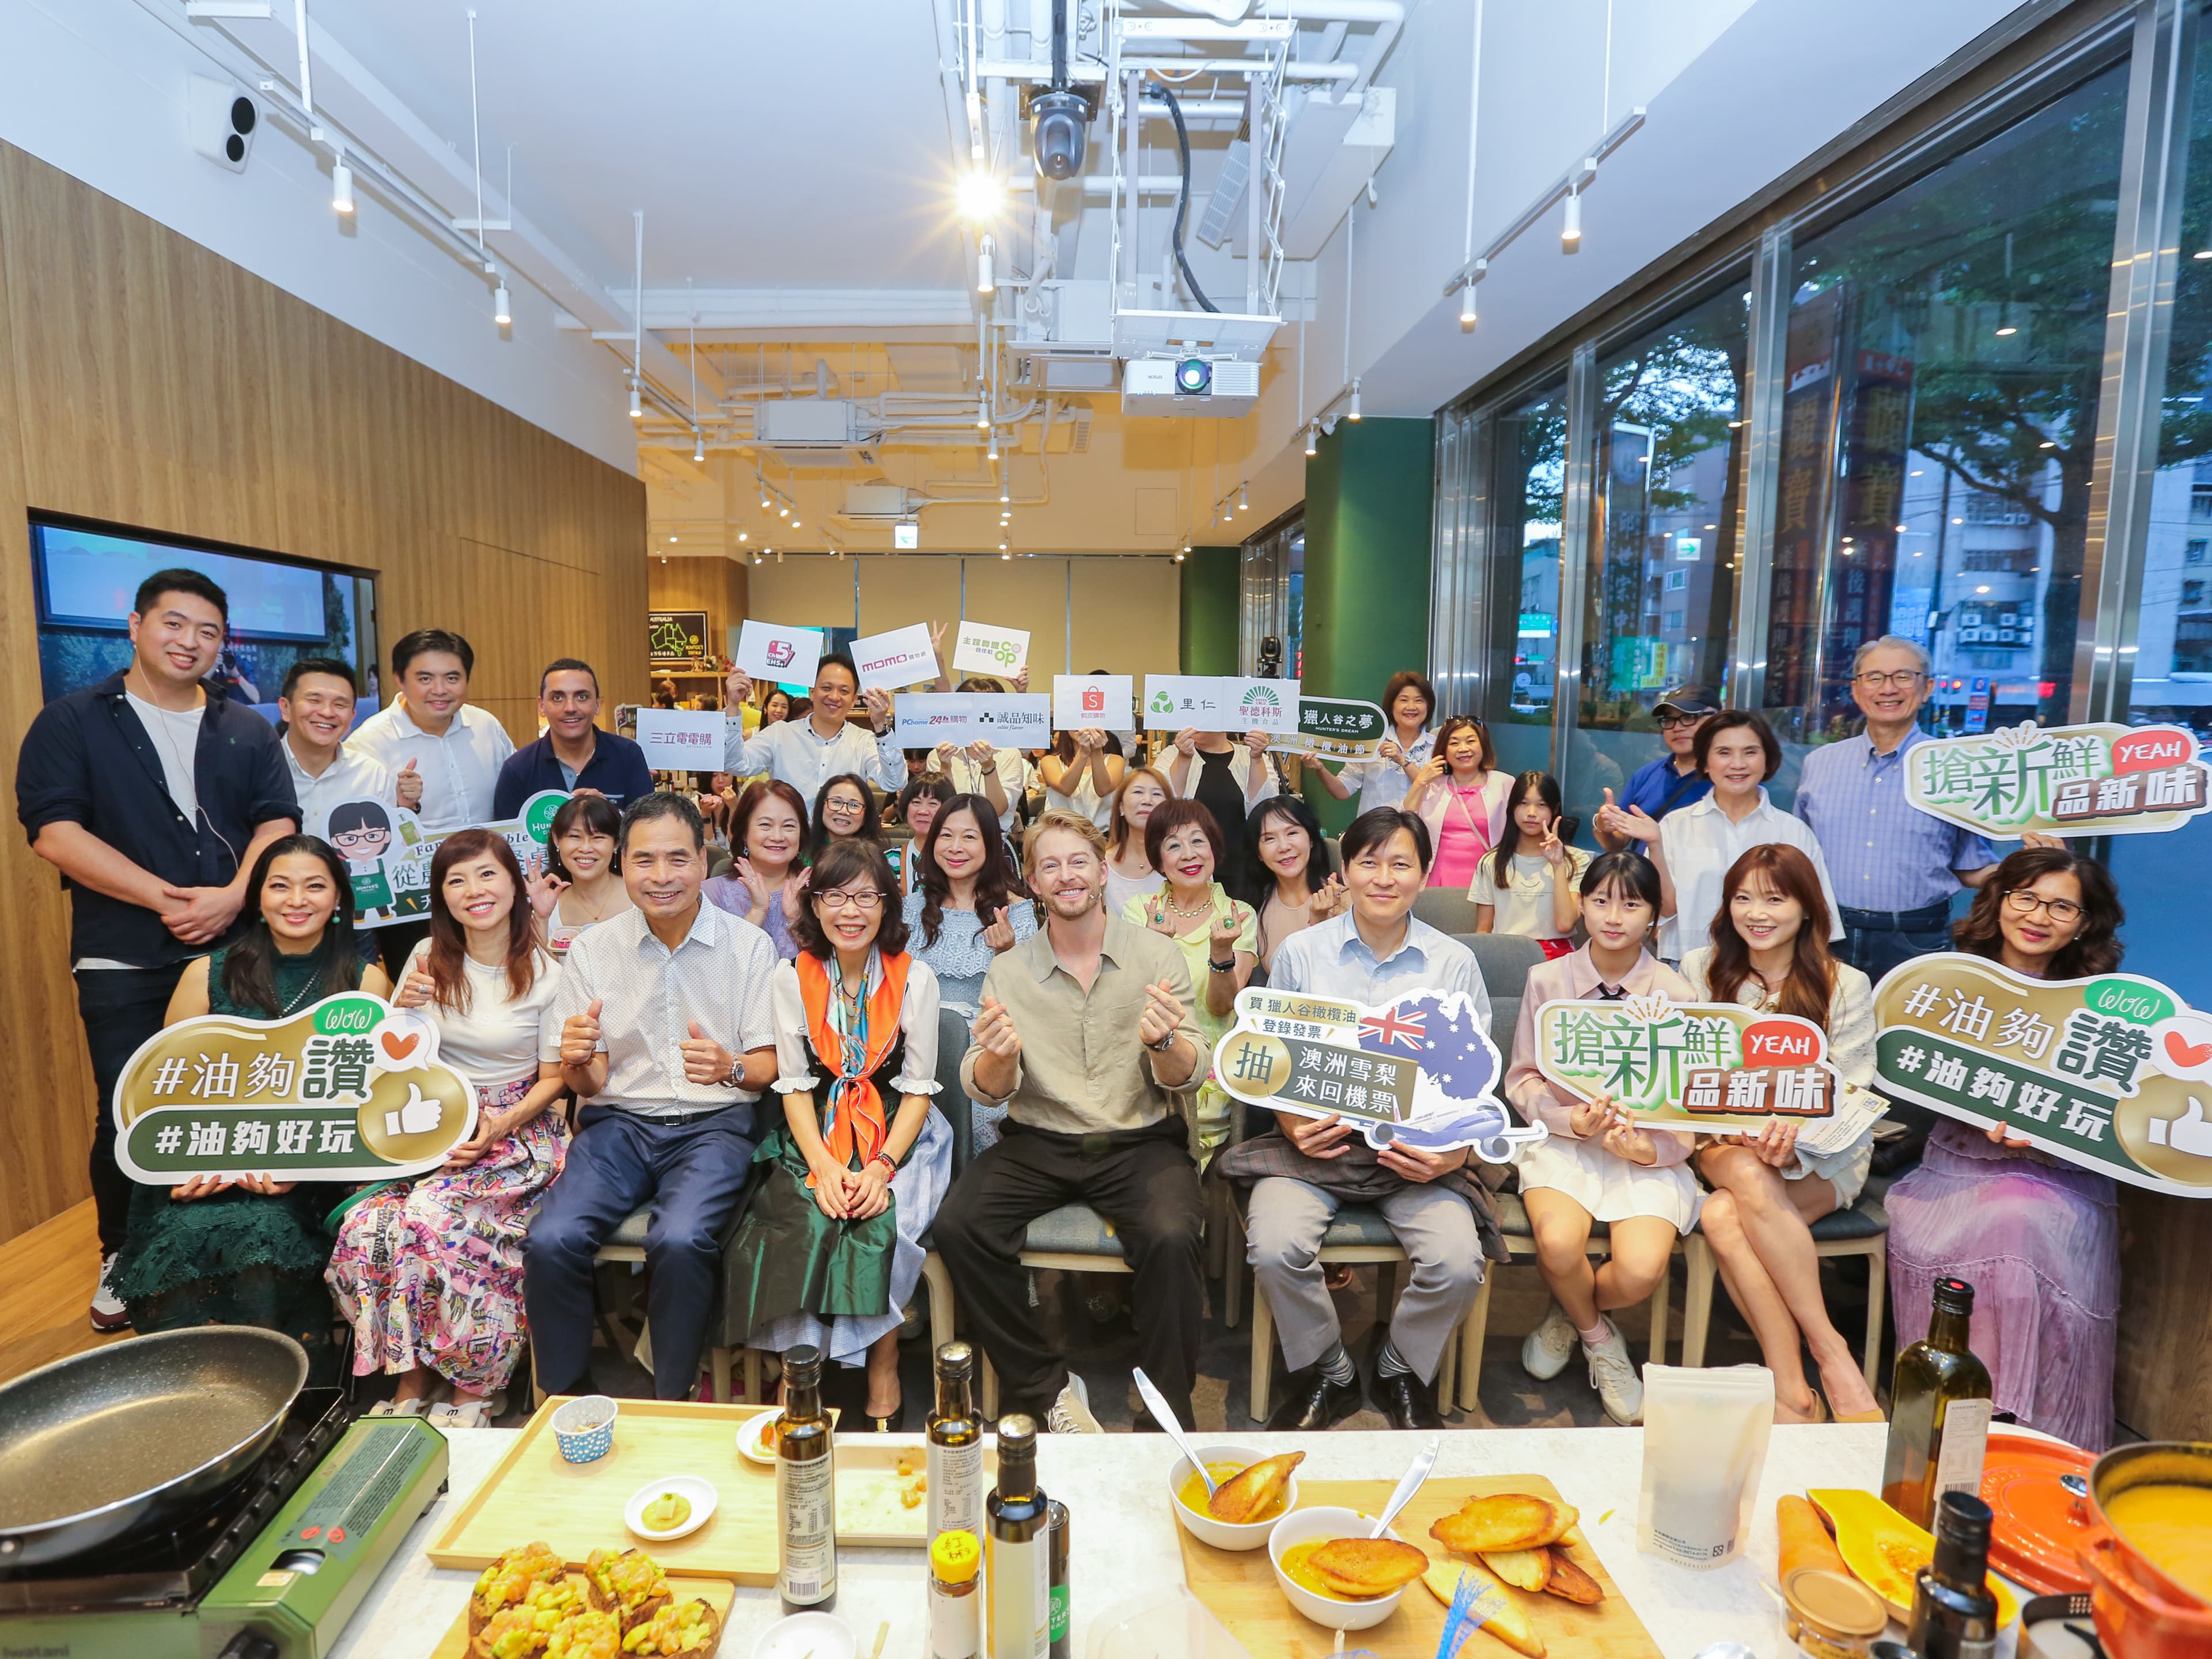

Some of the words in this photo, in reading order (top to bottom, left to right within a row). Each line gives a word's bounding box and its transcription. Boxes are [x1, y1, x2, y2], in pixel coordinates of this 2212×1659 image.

[862, 654, 908, 672] momo
[997, 712, 1044, 724] 誠品知味
[1180, 698, 1217, 710] 里仁
[1239, 706, 1282, 718] 聖德科斯
[1304, 709, 1374, 729] 獵人谷之夢
[650, 732, 712, 745] 三立電電購
[2120, 741, 2181, 763] YEAH
[1923, 738, 2101, 816] 搶新鮮
[2056, 766, 2198, 815] 品新味
[1262, 1018, 1322, 1039] 登錄發票
[1554, 1011, 1732, 1100] 搶新鮮
[1751, 1035, 1810, 1056] YEAH
[1233, 1041, 1274, 1084] 抽
[1299, 1046, 1397, 1087] 澳洲雪梨
[1292, 1074, 1395, 1115] 來回機票
[1687, 1067, 1827, 1110] 品新味
[1896, 1044, 2113, 1143] #油夠好玩
[154, 1119, 357, 1157] #油夠好玩
